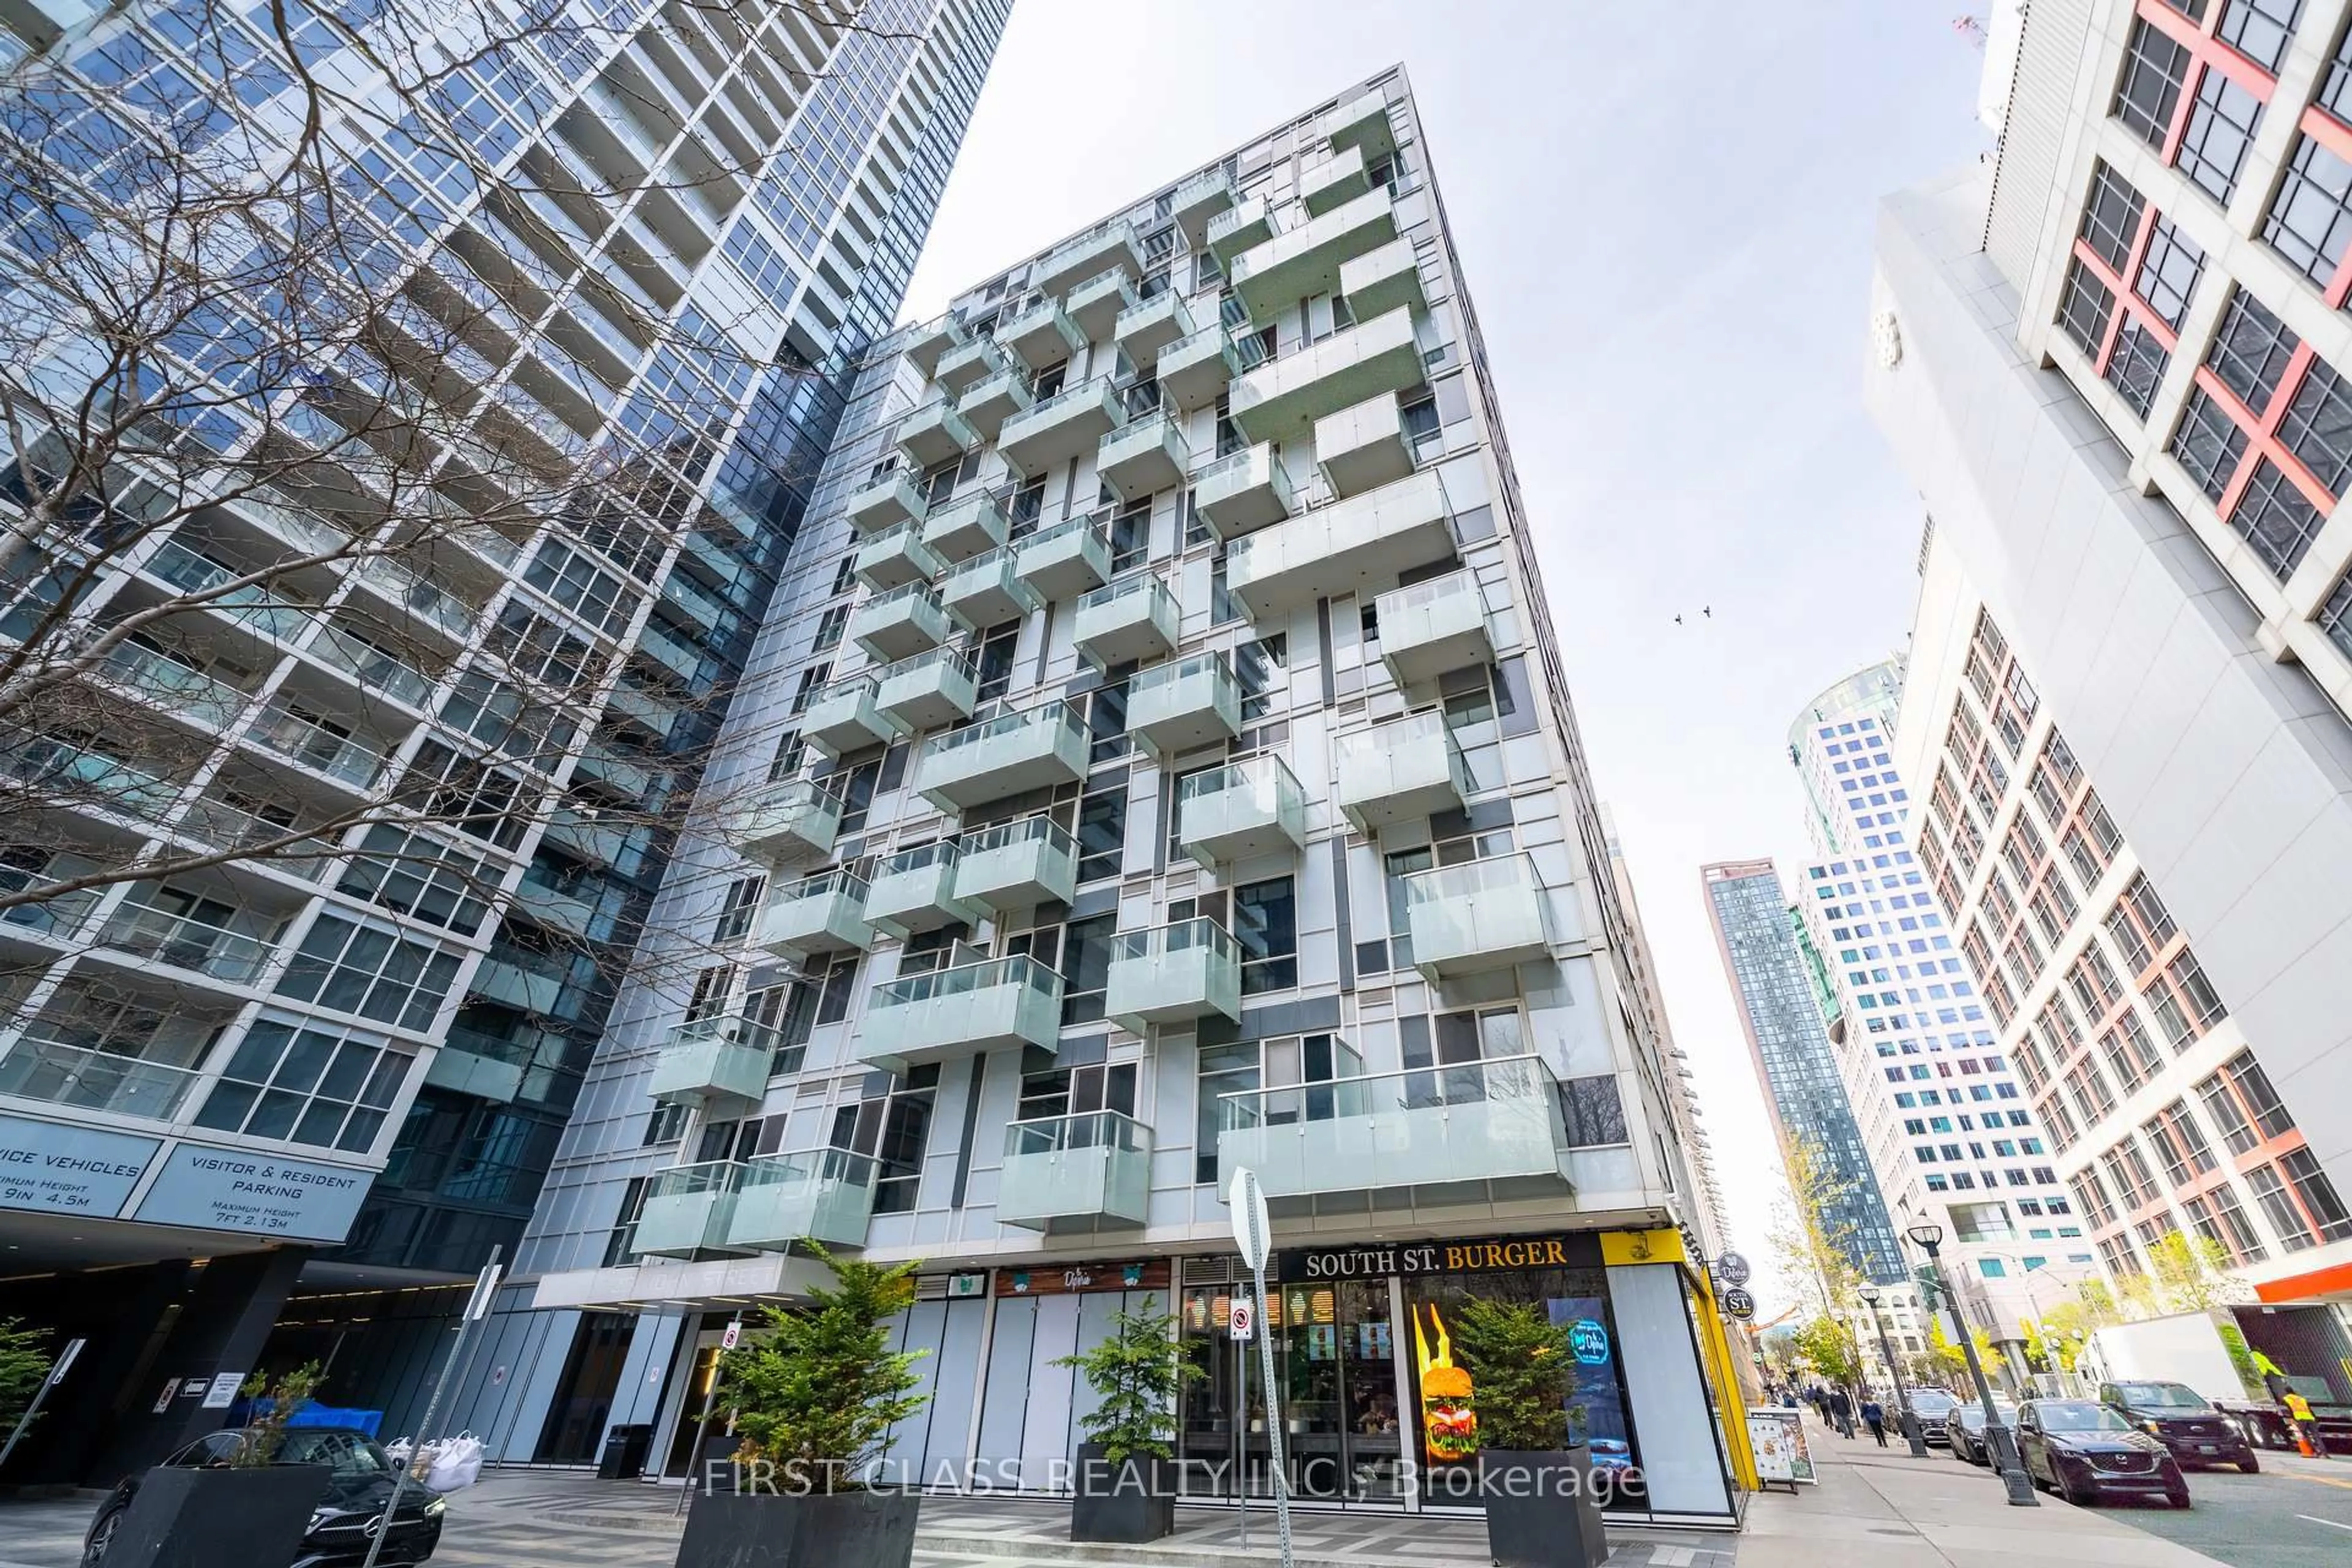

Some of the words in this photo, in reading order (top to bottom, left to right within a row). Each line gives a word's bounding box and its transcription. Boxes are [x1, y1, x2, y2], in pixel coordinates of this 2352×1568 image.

[46, 1155, 140, 1177] VEHICLES
[192, 1156, 257, 1176] VISITOR
[261, 1166, 274, 1178] &
[281, 1170, 357, 1189] RESIDENT
[0, 1175, 36, 1187] IMUM
[40, 1179, 89, 1193] HEIGHT
[232, 1180, 303, 1199] PARKING
[4, 1188, 34, 1200] 9IN
[211, 1200, 261, 1213] MAXIMUM
[263, 1207, 302, 1219] HEIGHT
[217, 1212, 241, 1226] 7FT
[1306, 1251, 1396, 1276] SOUTH
[1404, 1249, 1440, 1272] ST.
[1446, 1241, 1567, 1269] BURGER
